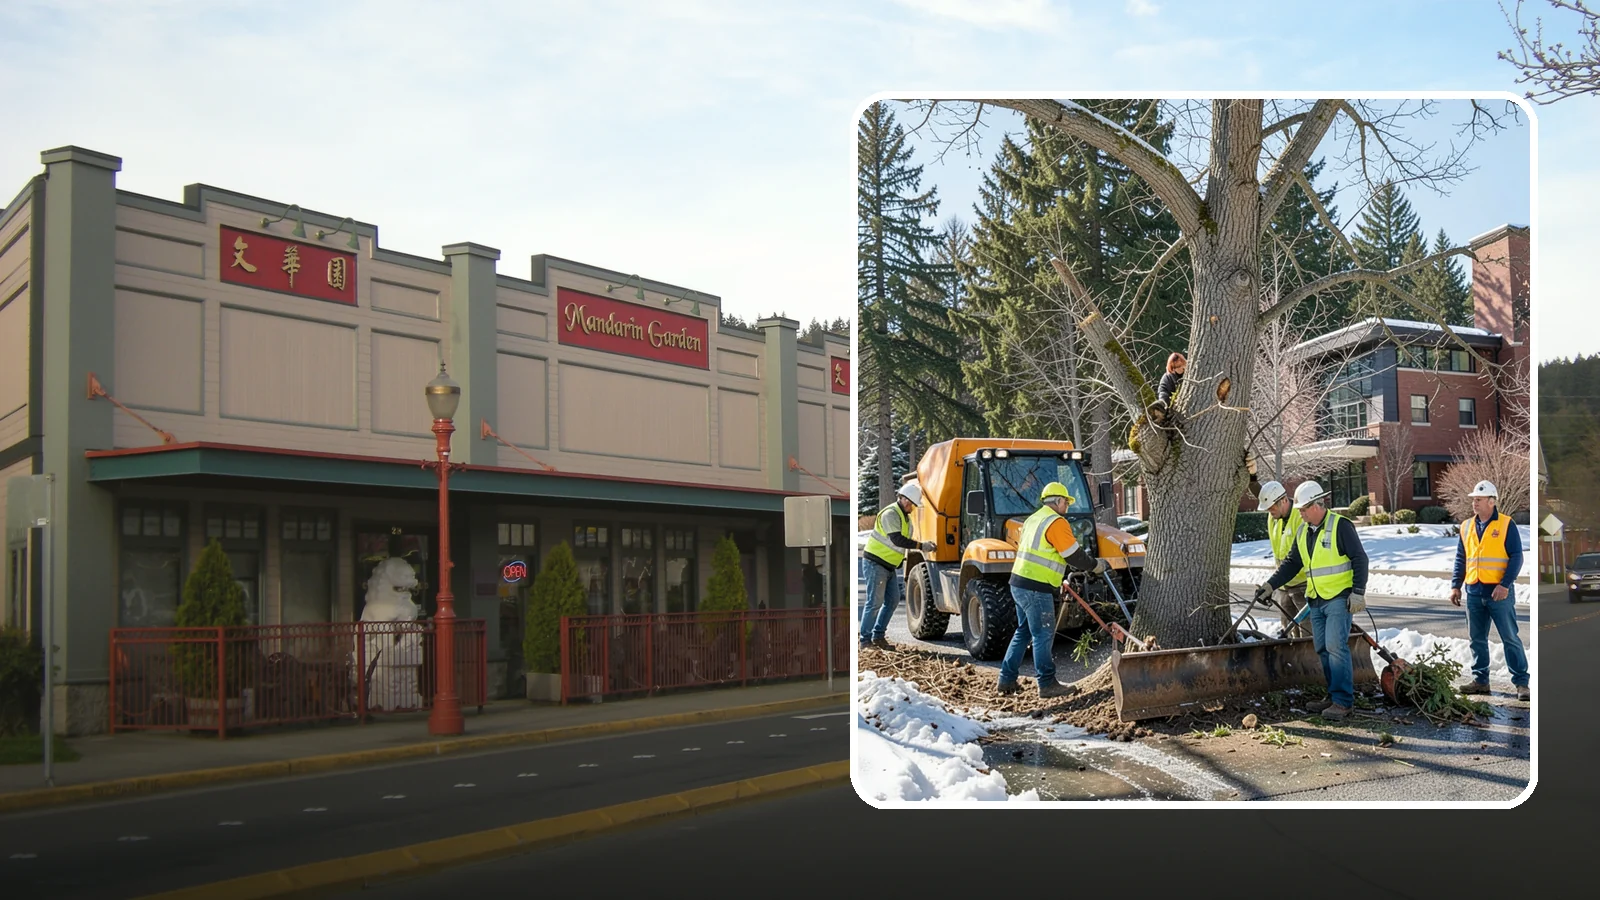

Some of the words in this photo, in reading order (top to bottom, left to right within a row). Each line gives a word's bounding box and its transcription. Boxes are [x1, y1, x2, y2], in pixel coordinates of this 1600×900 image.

[231, 235, 346, 291] 文華園
[564, 302, 644, 341] Mandarin
[648, 320, 701, 352] Garden
[503, 565, 527, 578] OPEN
